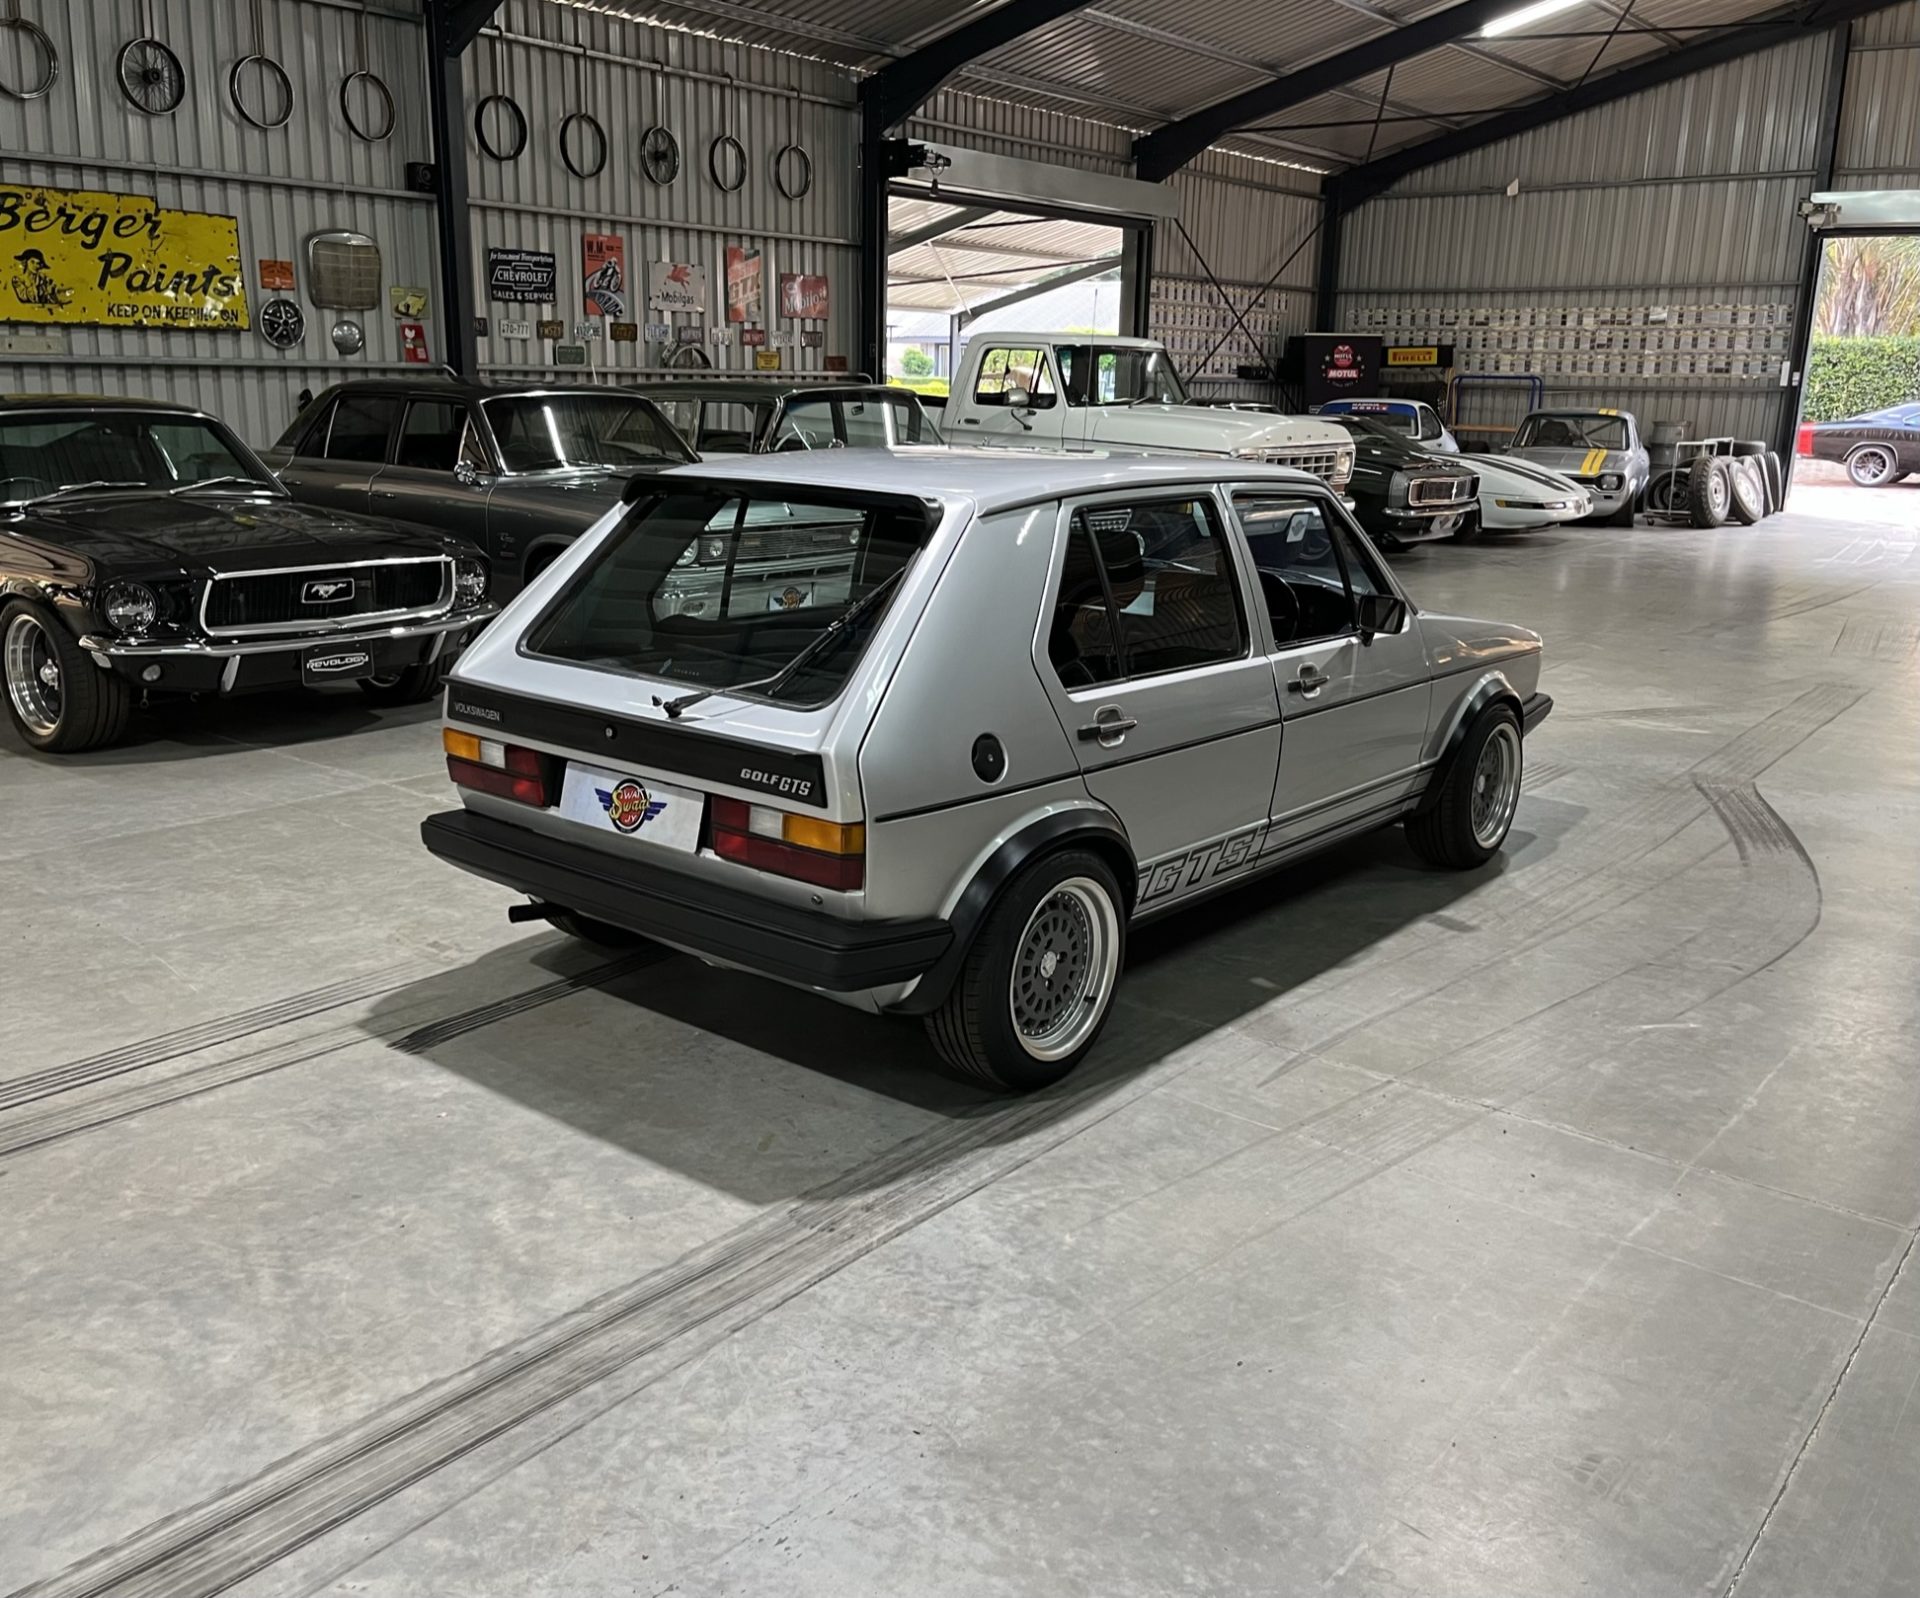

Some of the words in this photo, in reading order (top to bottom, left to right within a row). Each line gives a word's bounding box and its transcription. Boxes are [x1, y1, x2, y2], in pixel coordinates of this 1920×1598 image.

[0, 191, 162, 249] Berger
[97, 251, 242, 297] Paints
[497, 270, 548, 283] CHEVROLET
[492, 289, 515, 299] SALES
[523, 292, 554, 301] SERVICE
[661, 291, 695, 307] Mobilgas
[107, 303, 139, 318] KEEP
[141, 304, 161, 319] ON
[221, 308, 239, 322] ON
[1328, 368, 1359, 379] MOTUL
[453, 701, 500, 721] VOLKSWAGEN
[740, 768, 780, 785] GOLF
[779, 776, 812, 796] GTS
[1139, 827, 1260, 905] GTS
